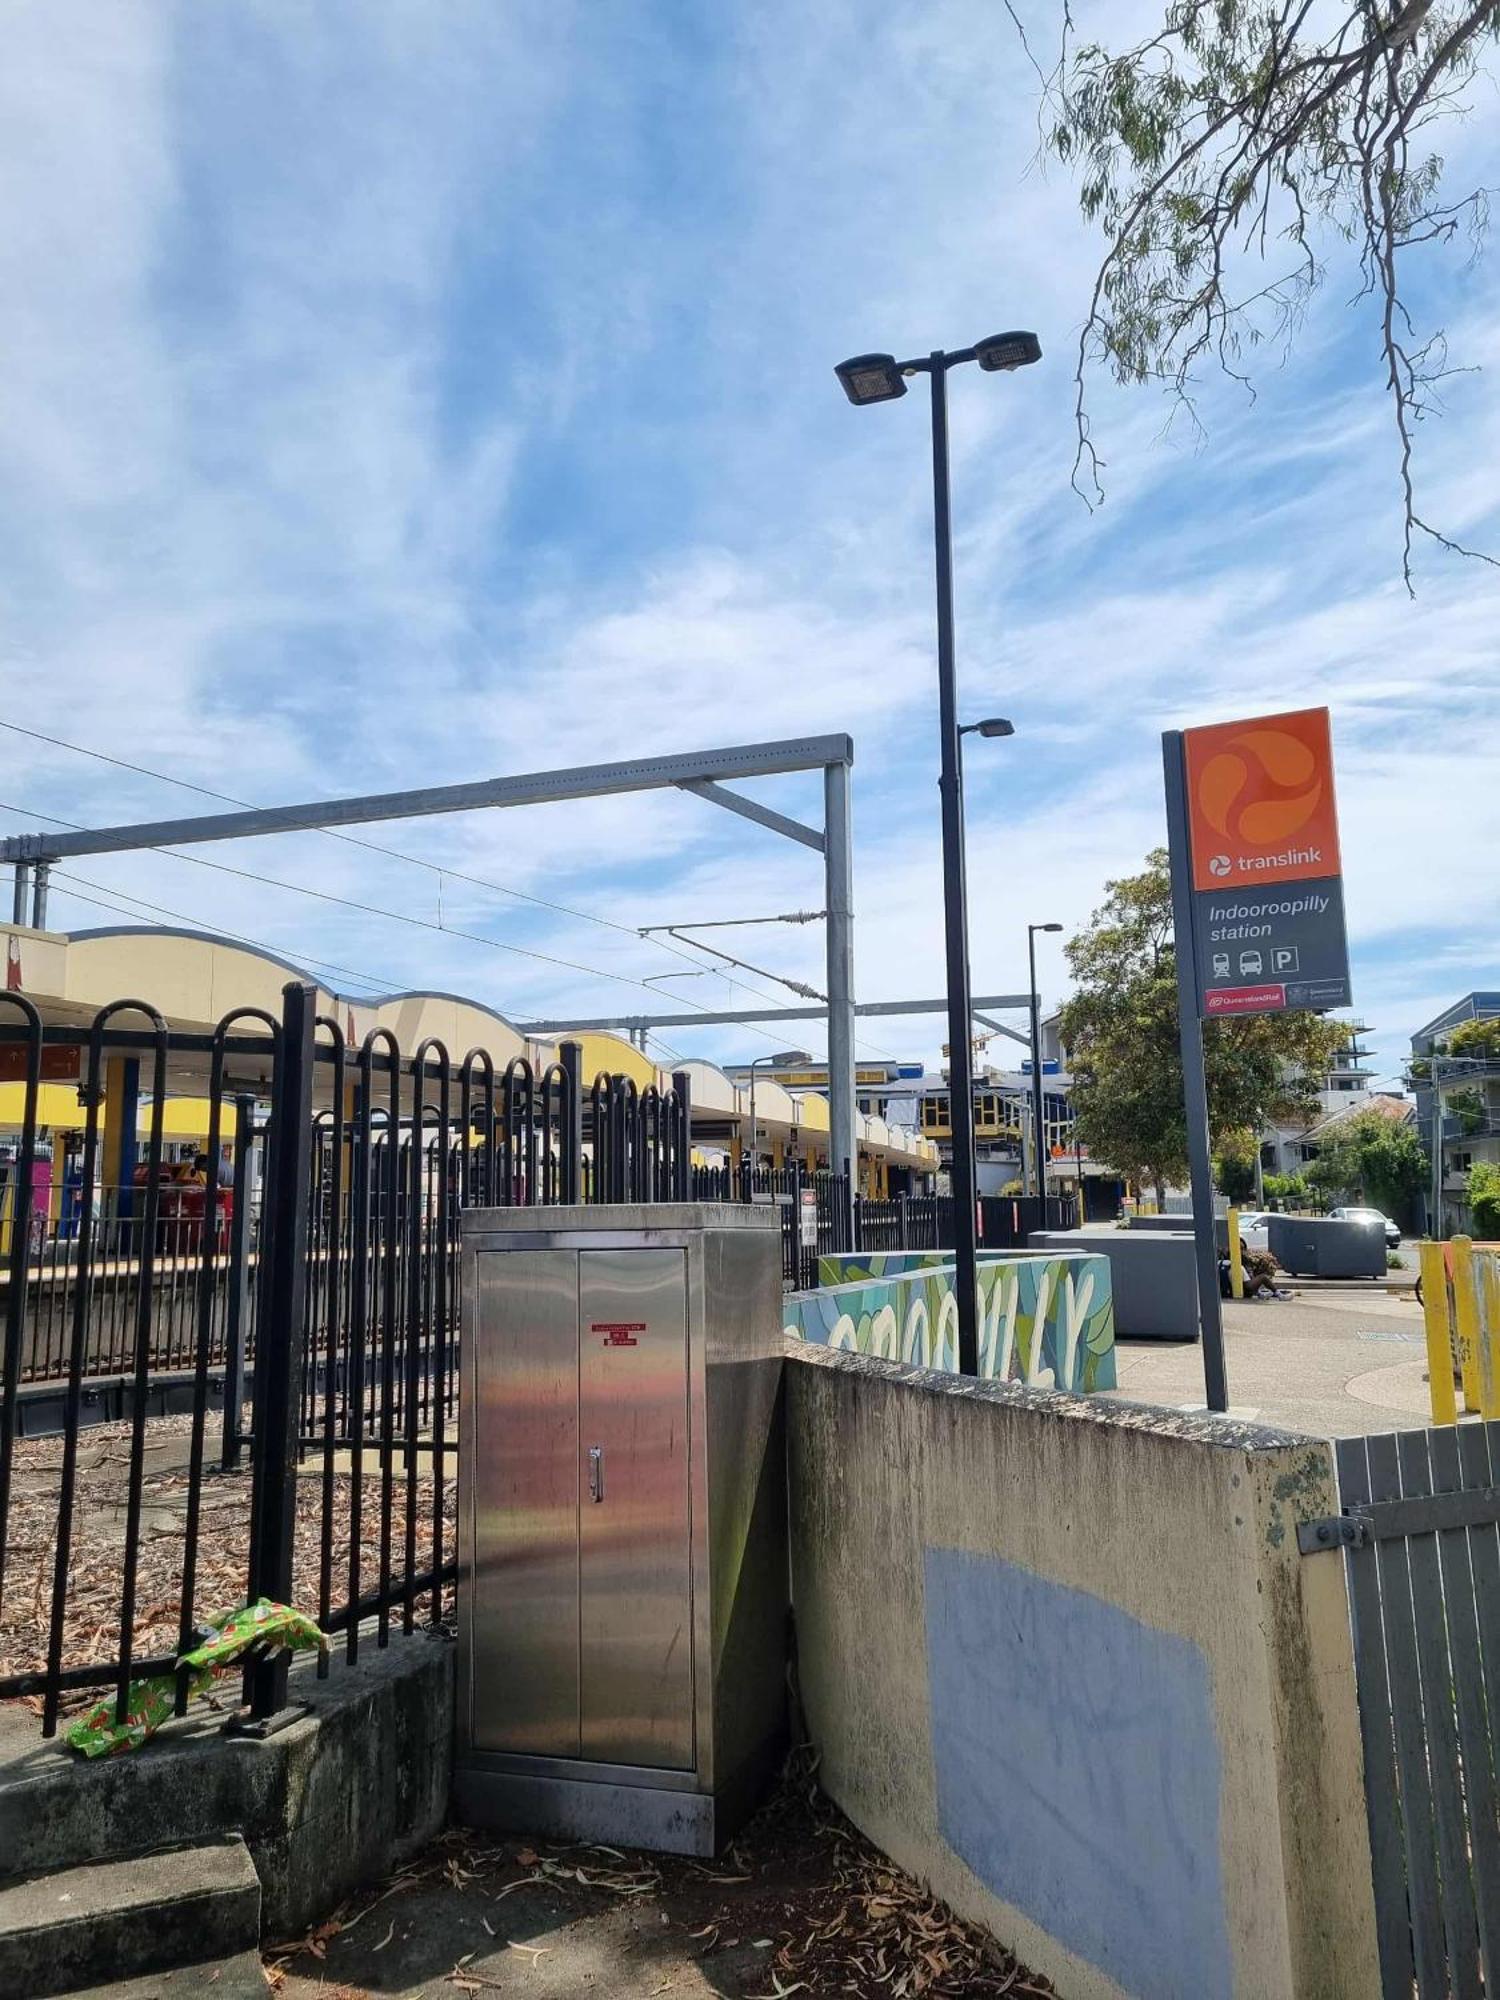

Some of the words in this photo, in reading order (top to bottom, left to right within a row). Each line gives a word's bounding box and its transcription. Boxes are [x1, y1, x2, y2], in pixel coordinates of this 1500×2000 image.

[1238, 847, 1321, 870] translink
[1210, 896, 1329, 921] Indooroopilly
[1210, 924, 1272, 941] station
[1276, 951, 1291, 969] P
